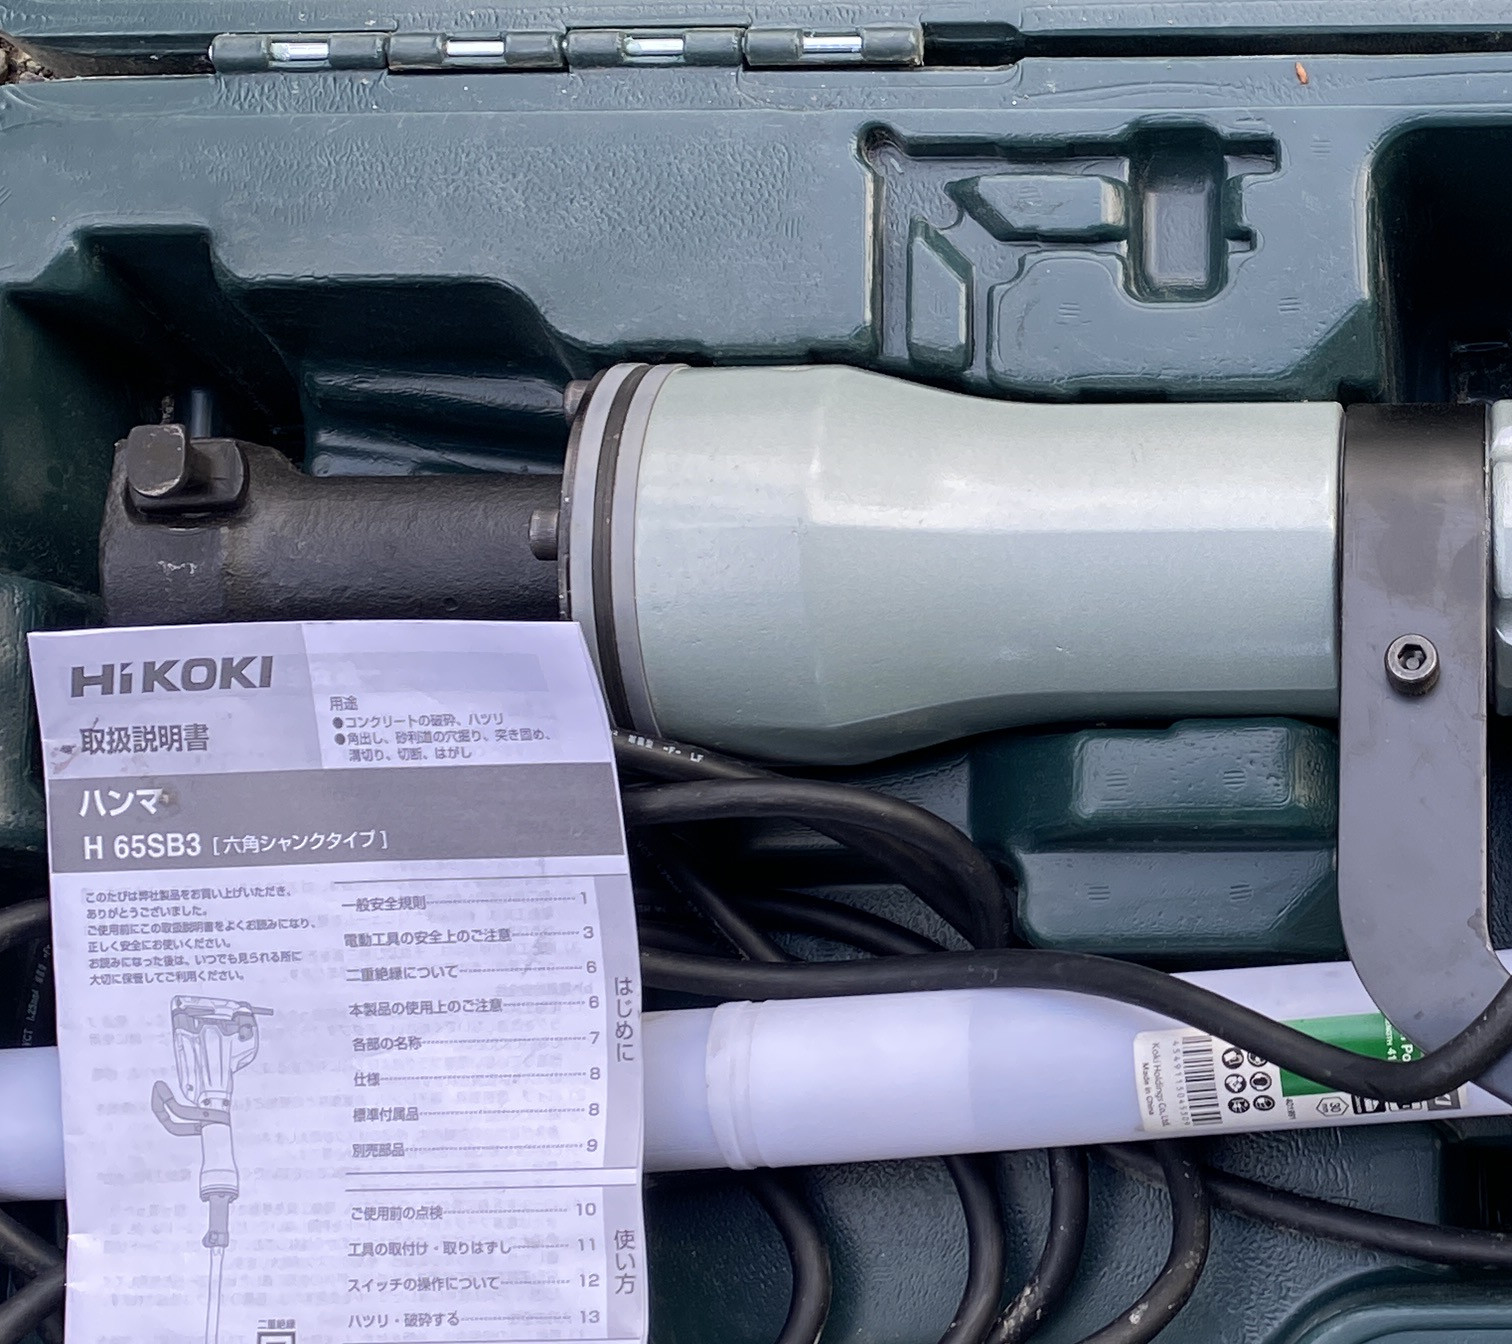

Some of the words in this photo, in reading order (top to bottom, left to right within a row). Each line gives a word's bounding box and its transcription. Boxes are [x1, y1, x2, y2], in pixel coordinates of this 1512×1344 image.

[71, 656, 273, 698] HiKOKI
[330, 696, 358, 711] 用途
[79, 723, 210, 755] 取扱説明書
[78, 788, 163, 817] ハンマ
[84, 836, 103, 860] H
[114, 833, 201, 858] 65SB3
[581, 891, 588, 905] 1
[86, 906, 208, 919] ありがとうございました。
[344, 927, 512, 948] 電動工具の安全上のご注意
[583, 925, 594, 939] 3
[346, 964, 459, 982] 二重絶縁について
[586, 960, 597, 974] 6
[349, 998, 503, 1017] 本製品の使用上のご注意
[589, 995, 600, 1009] 6
[614, 977, 634, 1062] はじめに
[352, 1036, 422, 1052] 各部の名称
[589, 1031, 600, 1044] 7
[353, 1072, 380, 1087] 仕様
[590, 1066, 601, 1080] 8
[1142, 1062, 1150, 1085] Made
[1146, 1096, 1155, 1116] China
[353, 1107, 419, 1123] 標準付属品
[588, 1103, 600, 1116] 8
[352, 1142, 405, 1158] 別売部品
[586, 1138, 598, 1152] 9
[351, 1205, 443, 1221] ご使用前の点検
[576, 1202, 596, 1216] 10
[577, 1237, 596, 1251] 11
[613, 1229, 636, 1295] 使い方
[348, 1275, 500, 1293] スイッチの操作について
[579, 1273, 600, 1288] 12
[580, 1310, 600, 1324] 13
